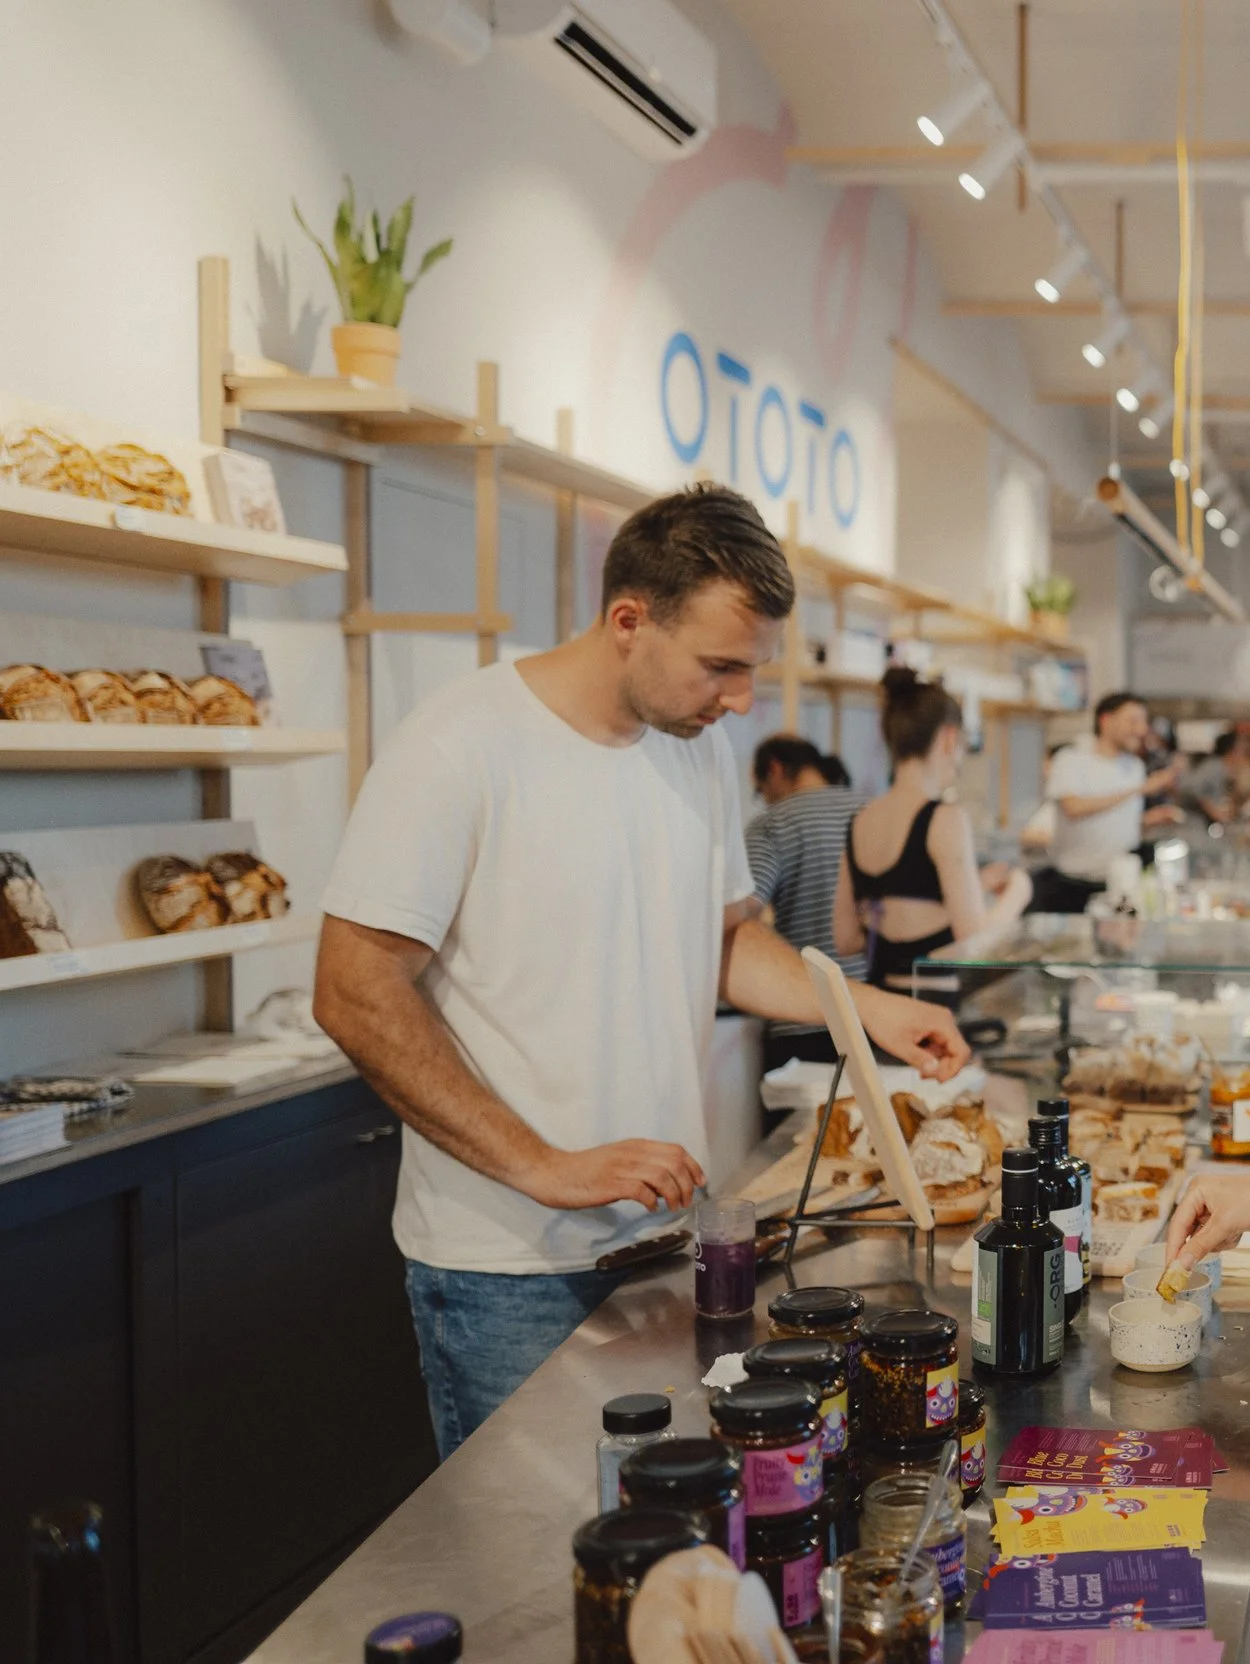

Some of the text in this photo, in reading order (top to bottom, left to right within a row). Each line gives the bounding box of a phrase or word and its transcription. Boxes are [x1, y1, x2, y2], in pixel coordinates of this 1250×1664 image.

[661, 331, 862, 530] OTOTO
[1047, 1453, 1069, 1467] Coco
[1059, 1574, 1080, 1608] Coconut
[1080, 1573, 1104, 1608] Caramel
